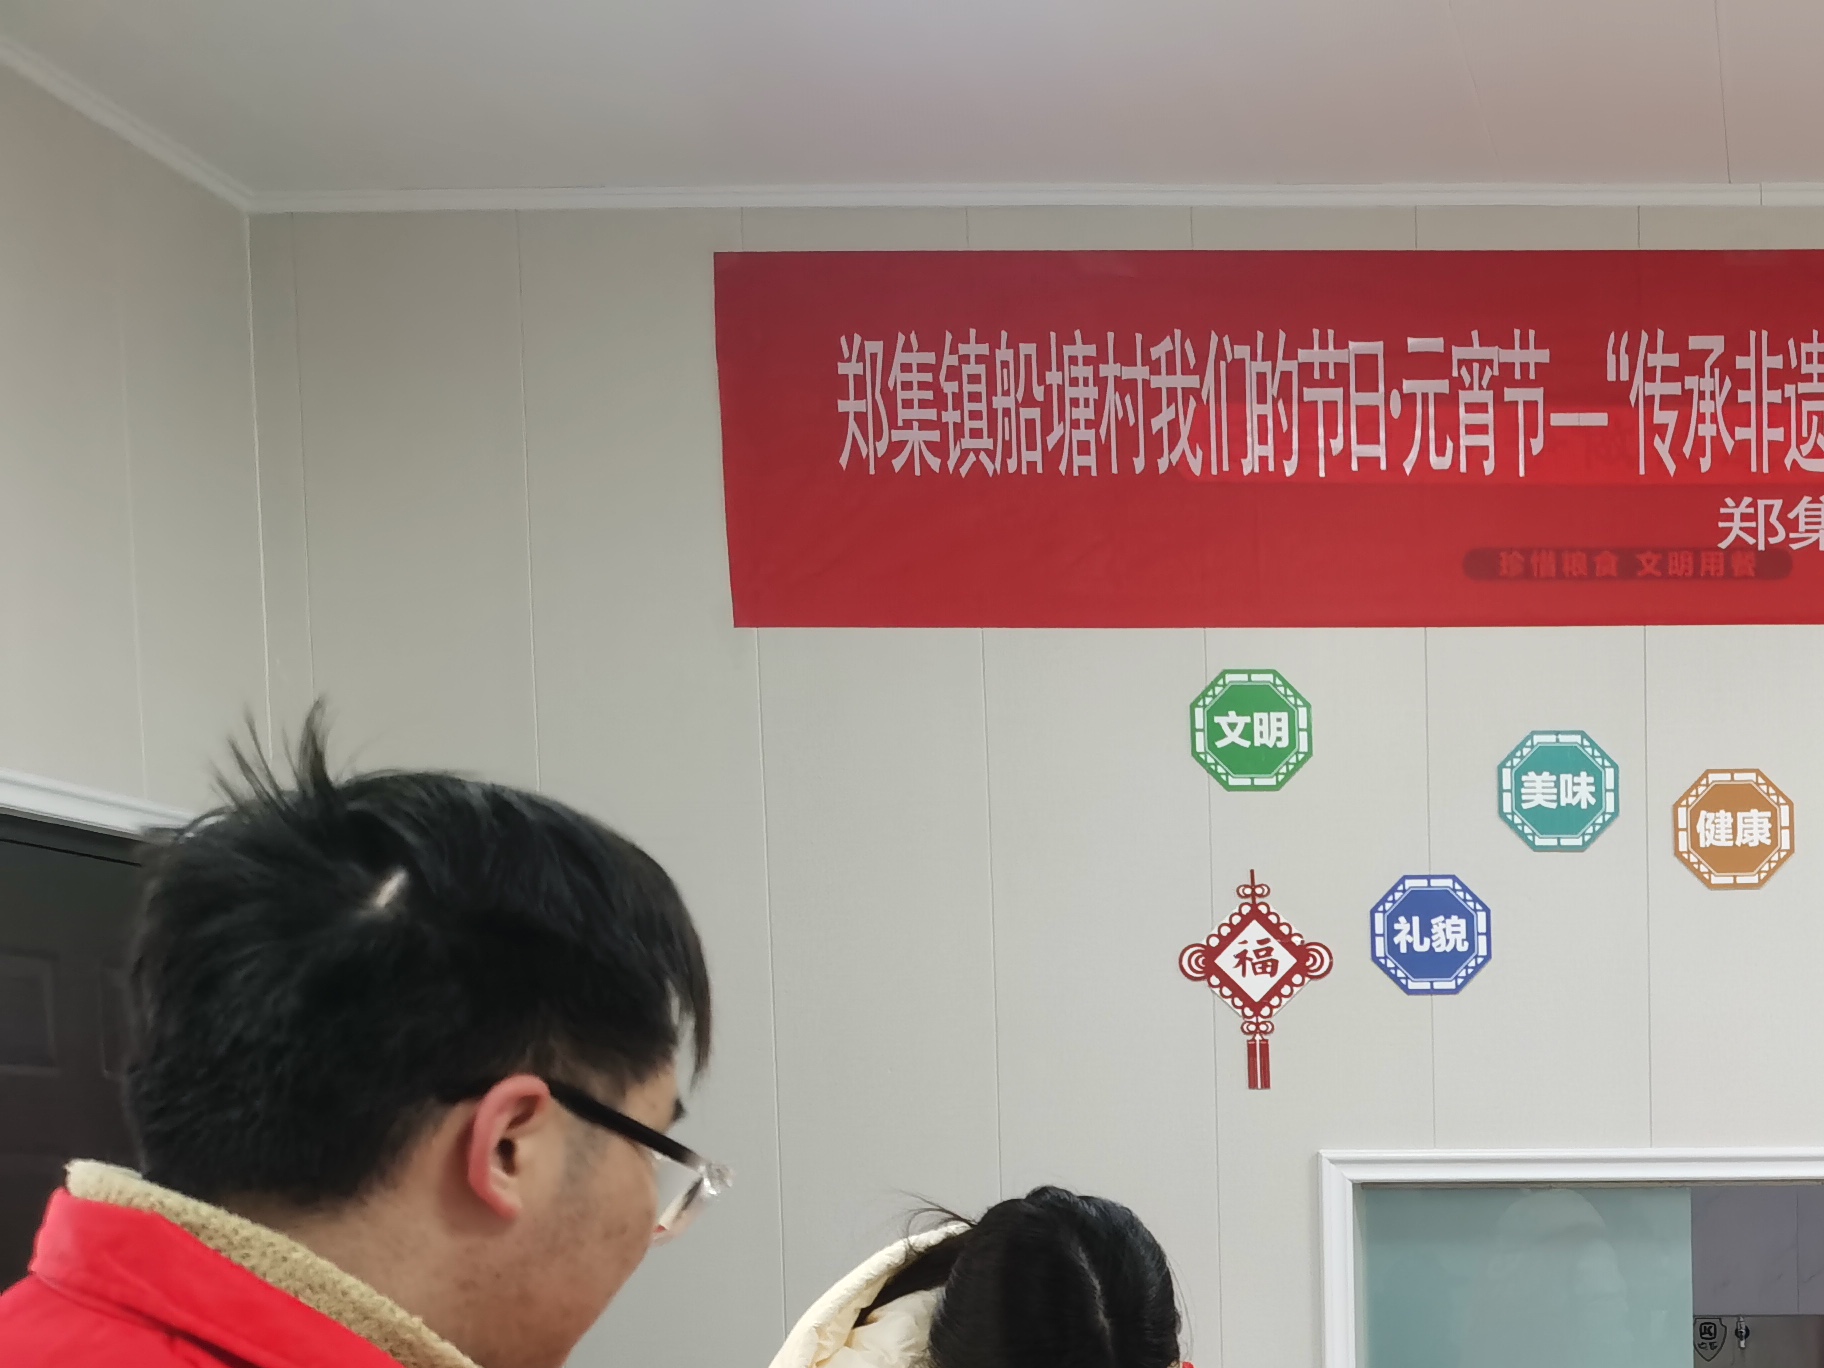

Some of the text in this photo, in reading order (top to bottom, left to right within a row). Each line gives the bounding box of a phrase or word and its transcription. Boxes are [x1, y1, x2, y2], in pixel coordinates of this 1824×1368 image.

[1213, 710, 1289, 749] 文明
[1521, 772, 1597, 811] 美味
[1696, 809, 1772, 848] 健康
[1393, 916, 1470, 955] 礼貌
[1232, 938, 1281, 980] 福
